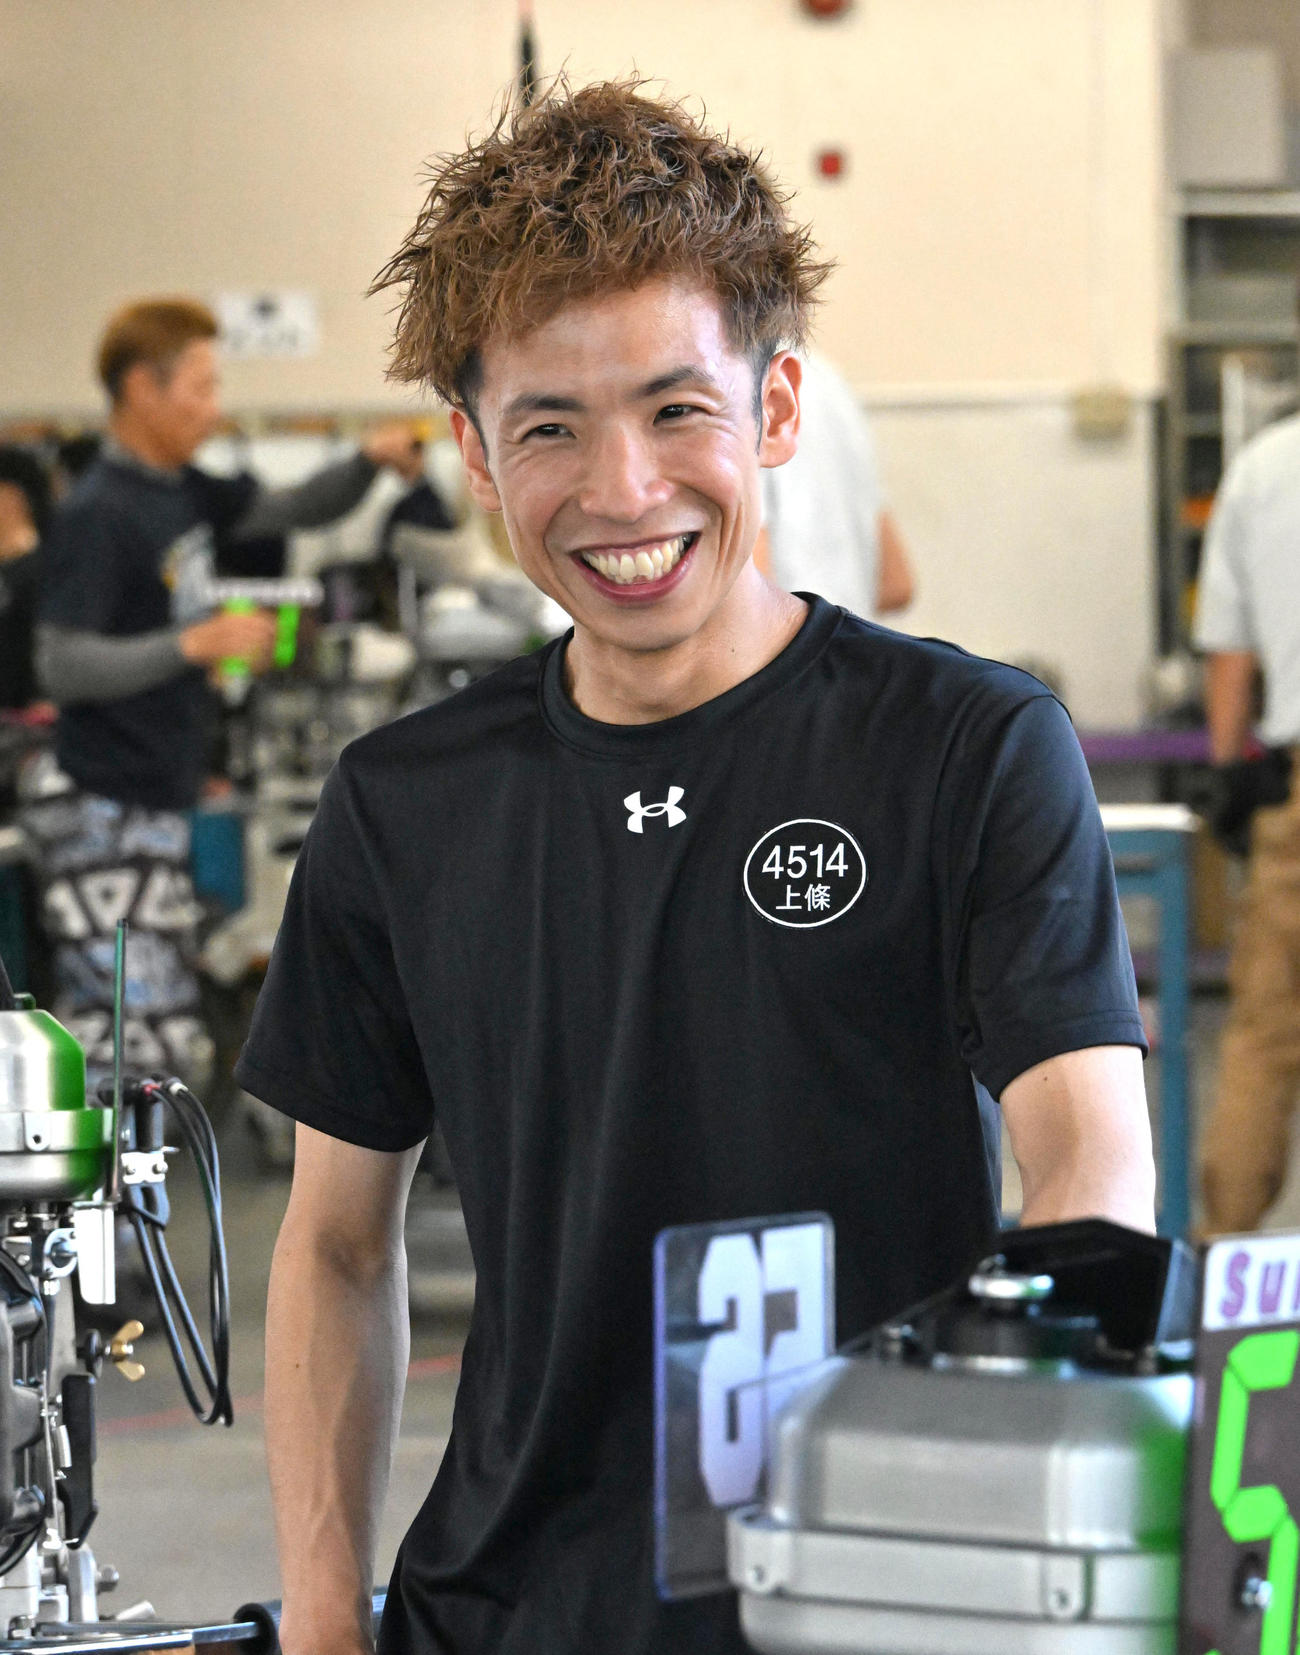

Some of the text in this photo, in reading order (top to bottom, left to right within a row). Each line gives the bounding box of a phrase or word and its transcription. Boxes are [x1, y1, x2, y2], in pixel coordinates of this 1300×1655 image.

[762, 842, 848, 879] 4514
[775, 883, 832, 912] 上條
[1220, 1251, 1300, 1318] Su
